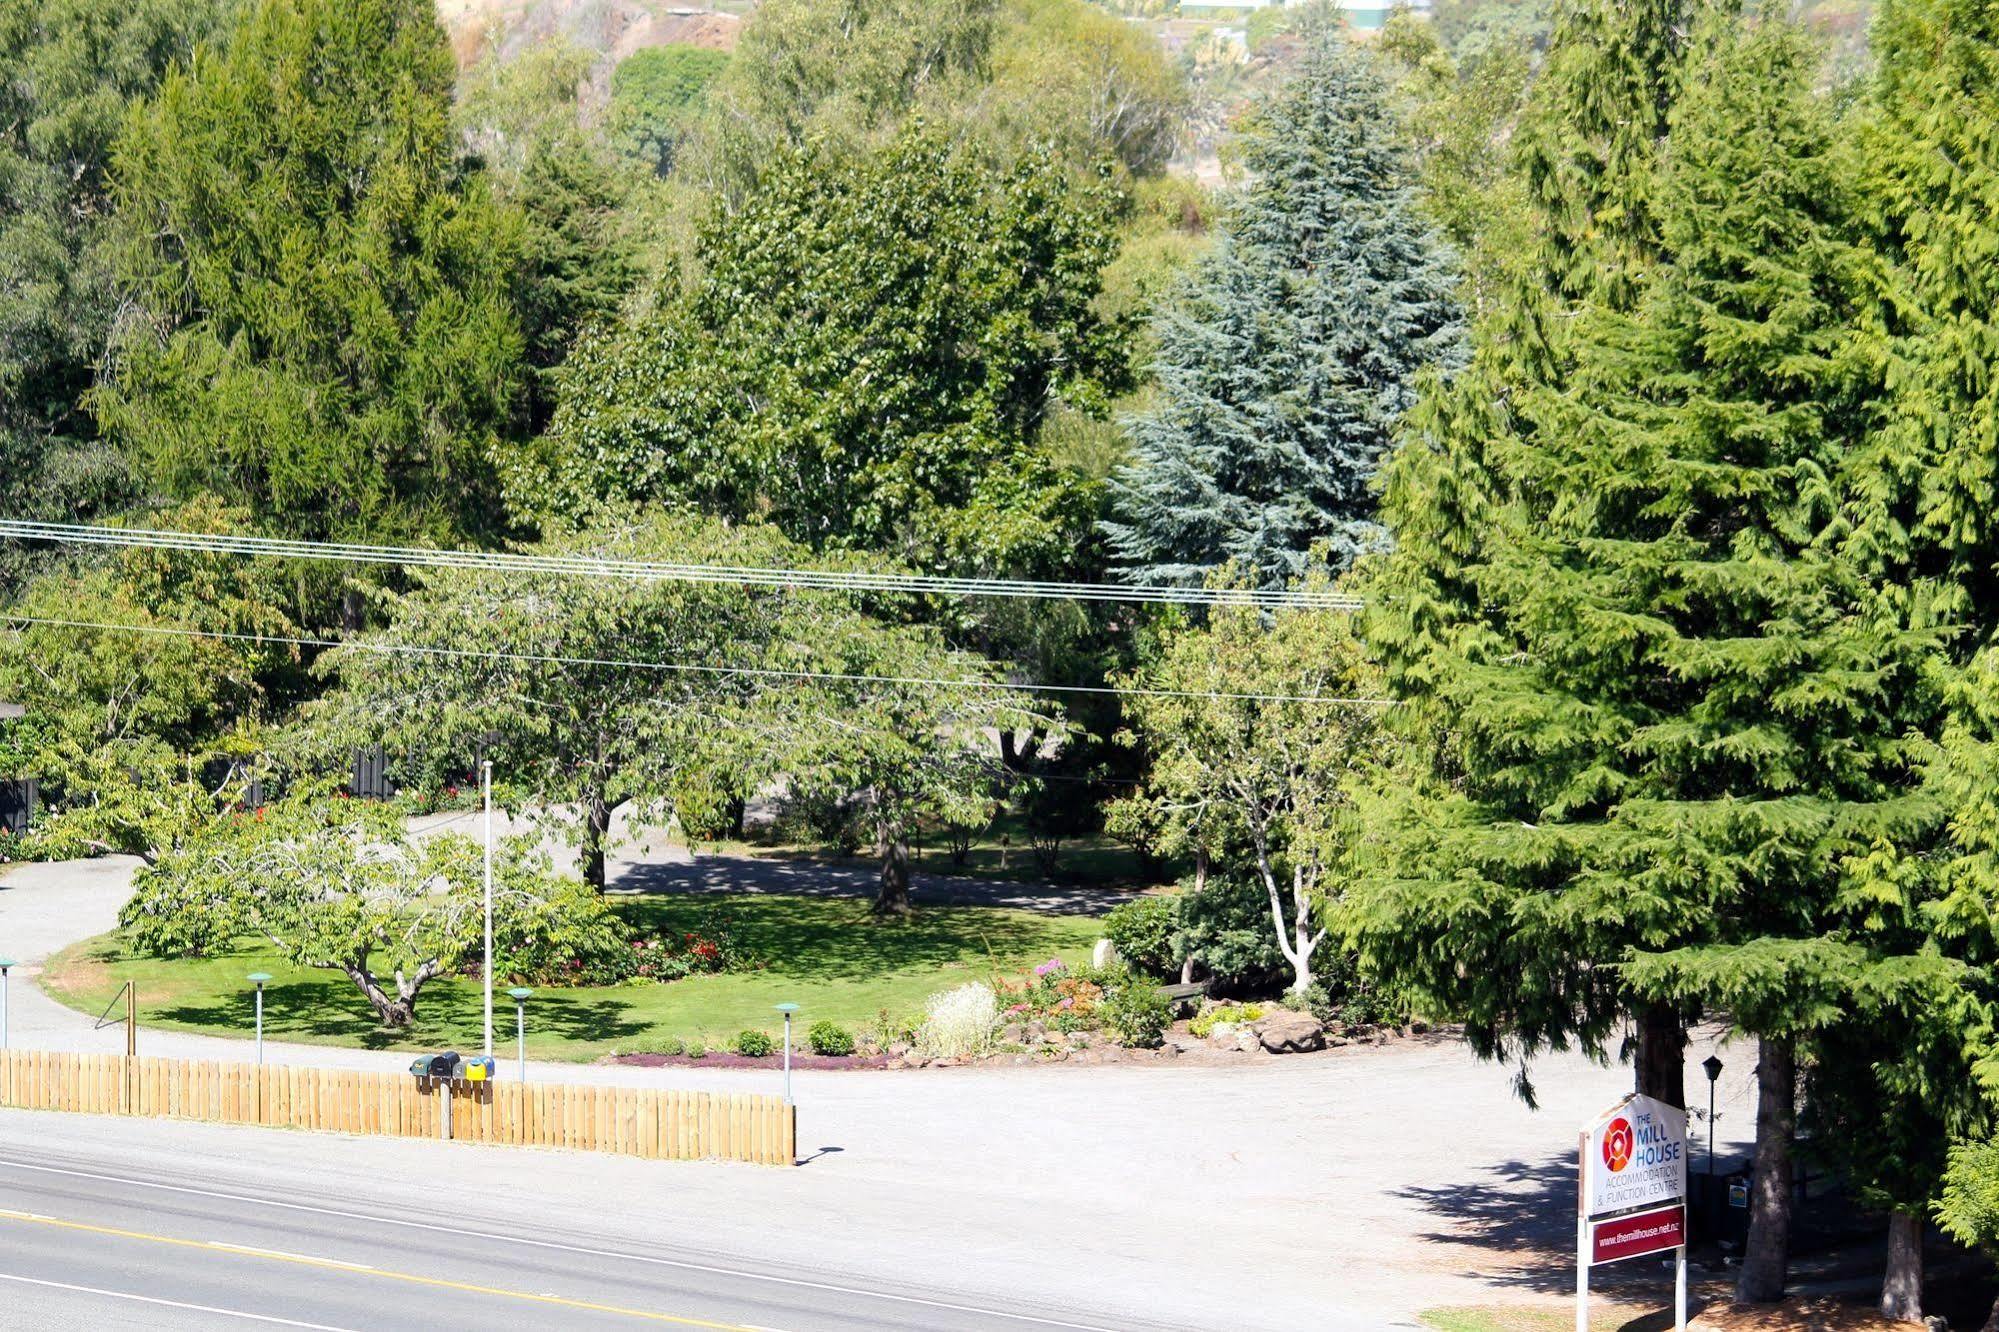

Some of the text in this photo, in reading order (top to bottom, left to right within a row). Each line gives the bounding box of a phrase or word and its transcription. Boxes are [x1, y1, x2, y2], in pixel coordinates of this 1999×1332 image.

[1637, 1113, 1651, 1124] THE
[1637, 1124, 1667, 1146] MILL
[1636, 1142, 1680, 1167] HOUSE
[1606, 1165, 1678, 1189] ACCOMMODATION
[1598, 1180, 1678, 1207] & FUNCTION CENTRE
[1599, 1222, 1680, 1247] www.themillhouse.net.nz
